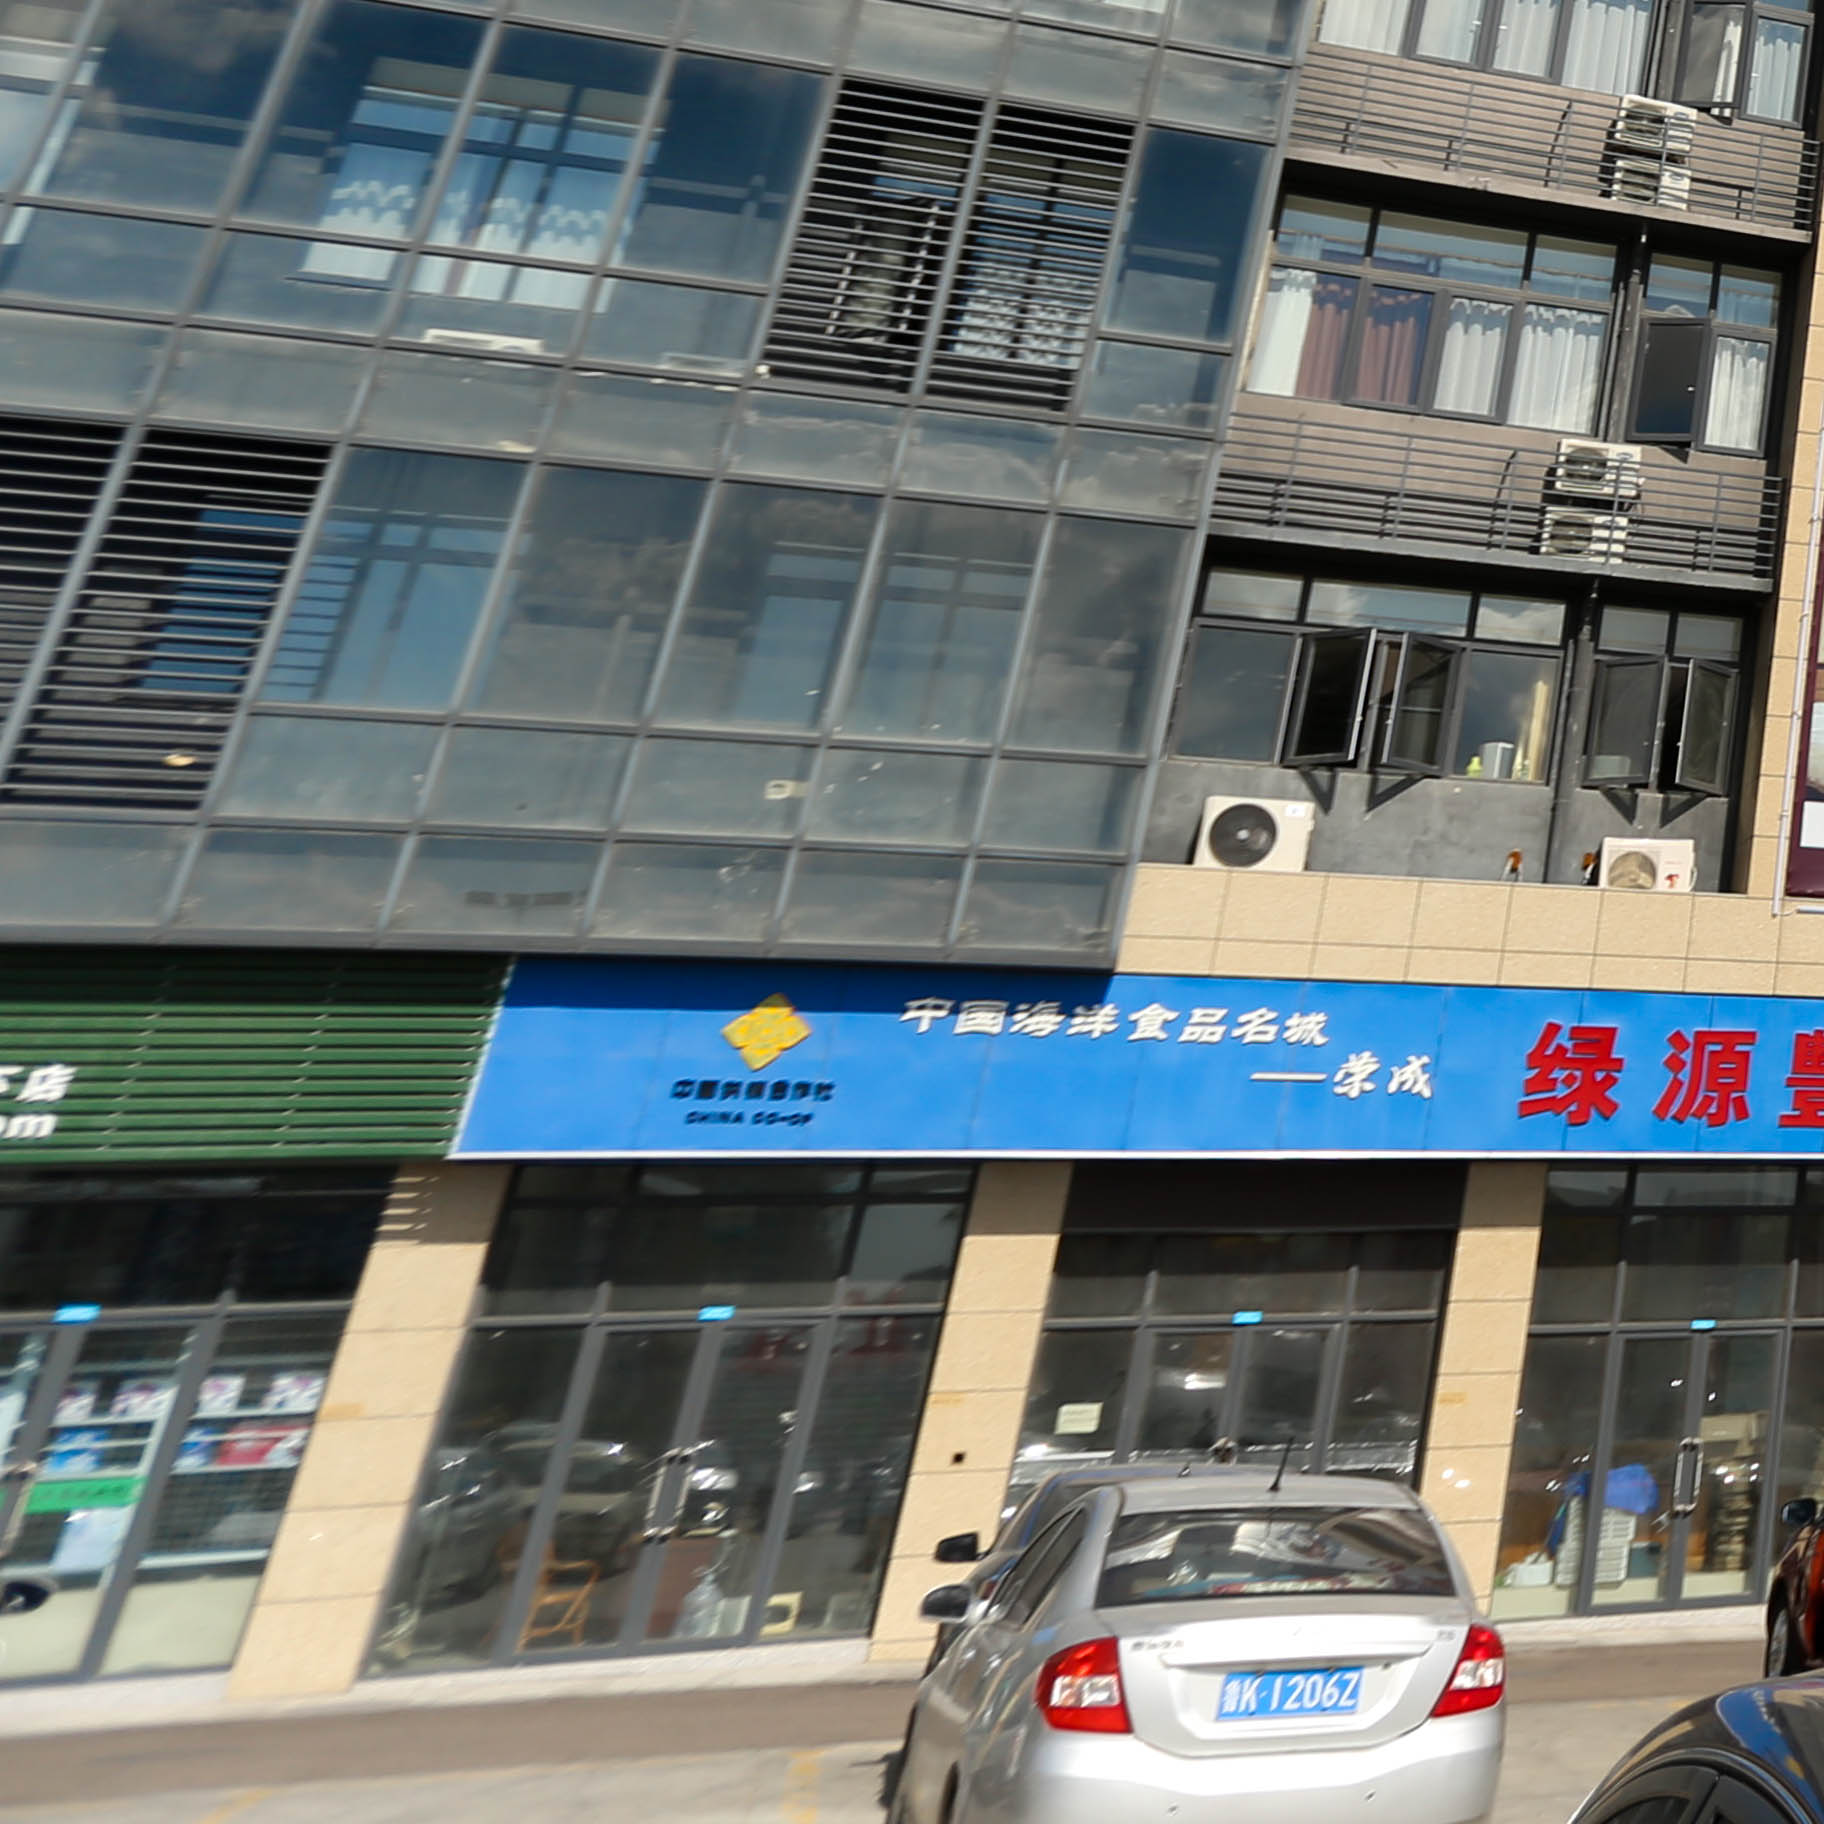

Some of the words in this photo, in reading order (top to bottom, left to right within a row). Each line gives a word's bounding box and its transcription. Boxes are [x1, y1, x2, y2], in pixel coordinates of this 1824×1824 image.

[899, 995, 1331, 1048] 中国海洋食品名城
